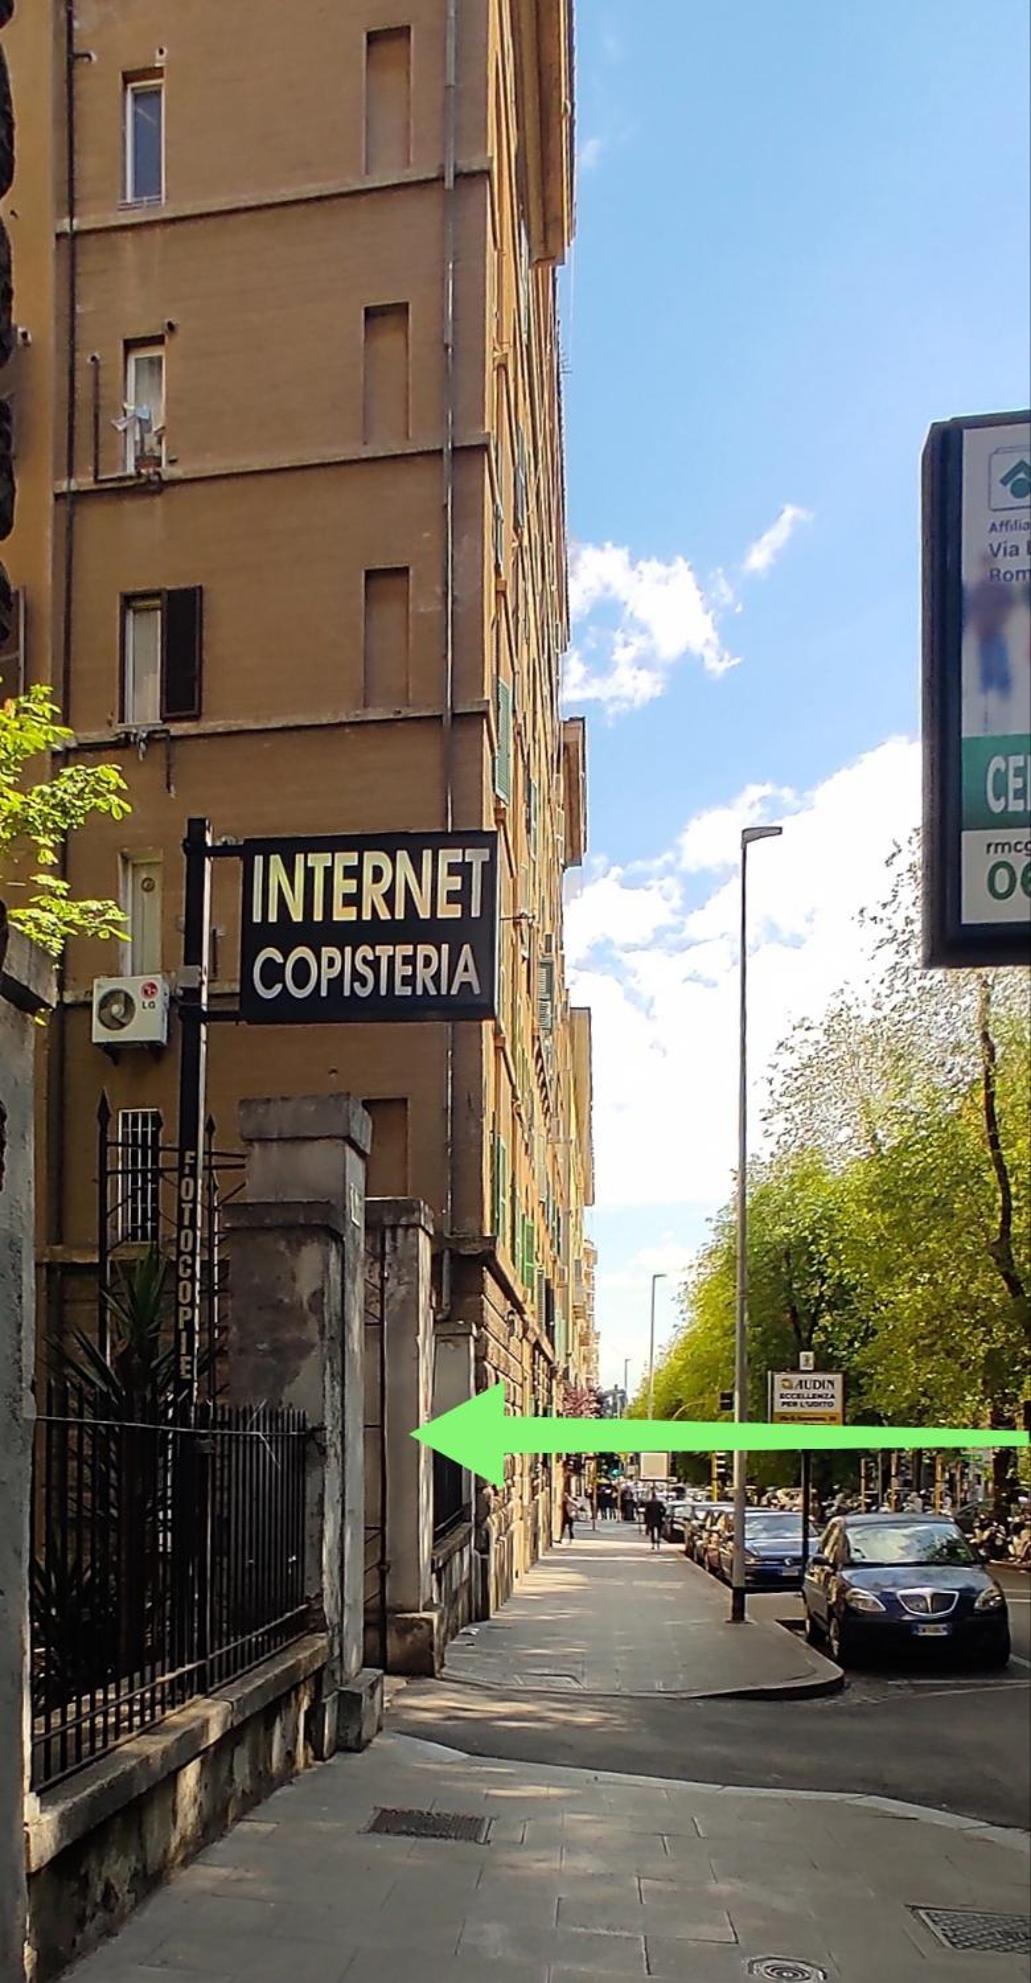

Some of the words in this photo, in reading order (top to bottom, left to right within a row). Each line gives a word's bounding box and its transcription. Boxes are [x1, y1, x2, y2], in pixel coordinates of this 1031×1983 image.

[989, 540, 1020, 557] Via
[986, 755, 1031, 814] CE
[252, 848, 490, 923] INTERNET
[253, 943, 481, 999] COPISTERIA
[142, 1001, 156, 1009] LG
[178, 1151, 195, 1379] FOTOCOPIE
[795, 1379, 835, 1390] AUDIN
